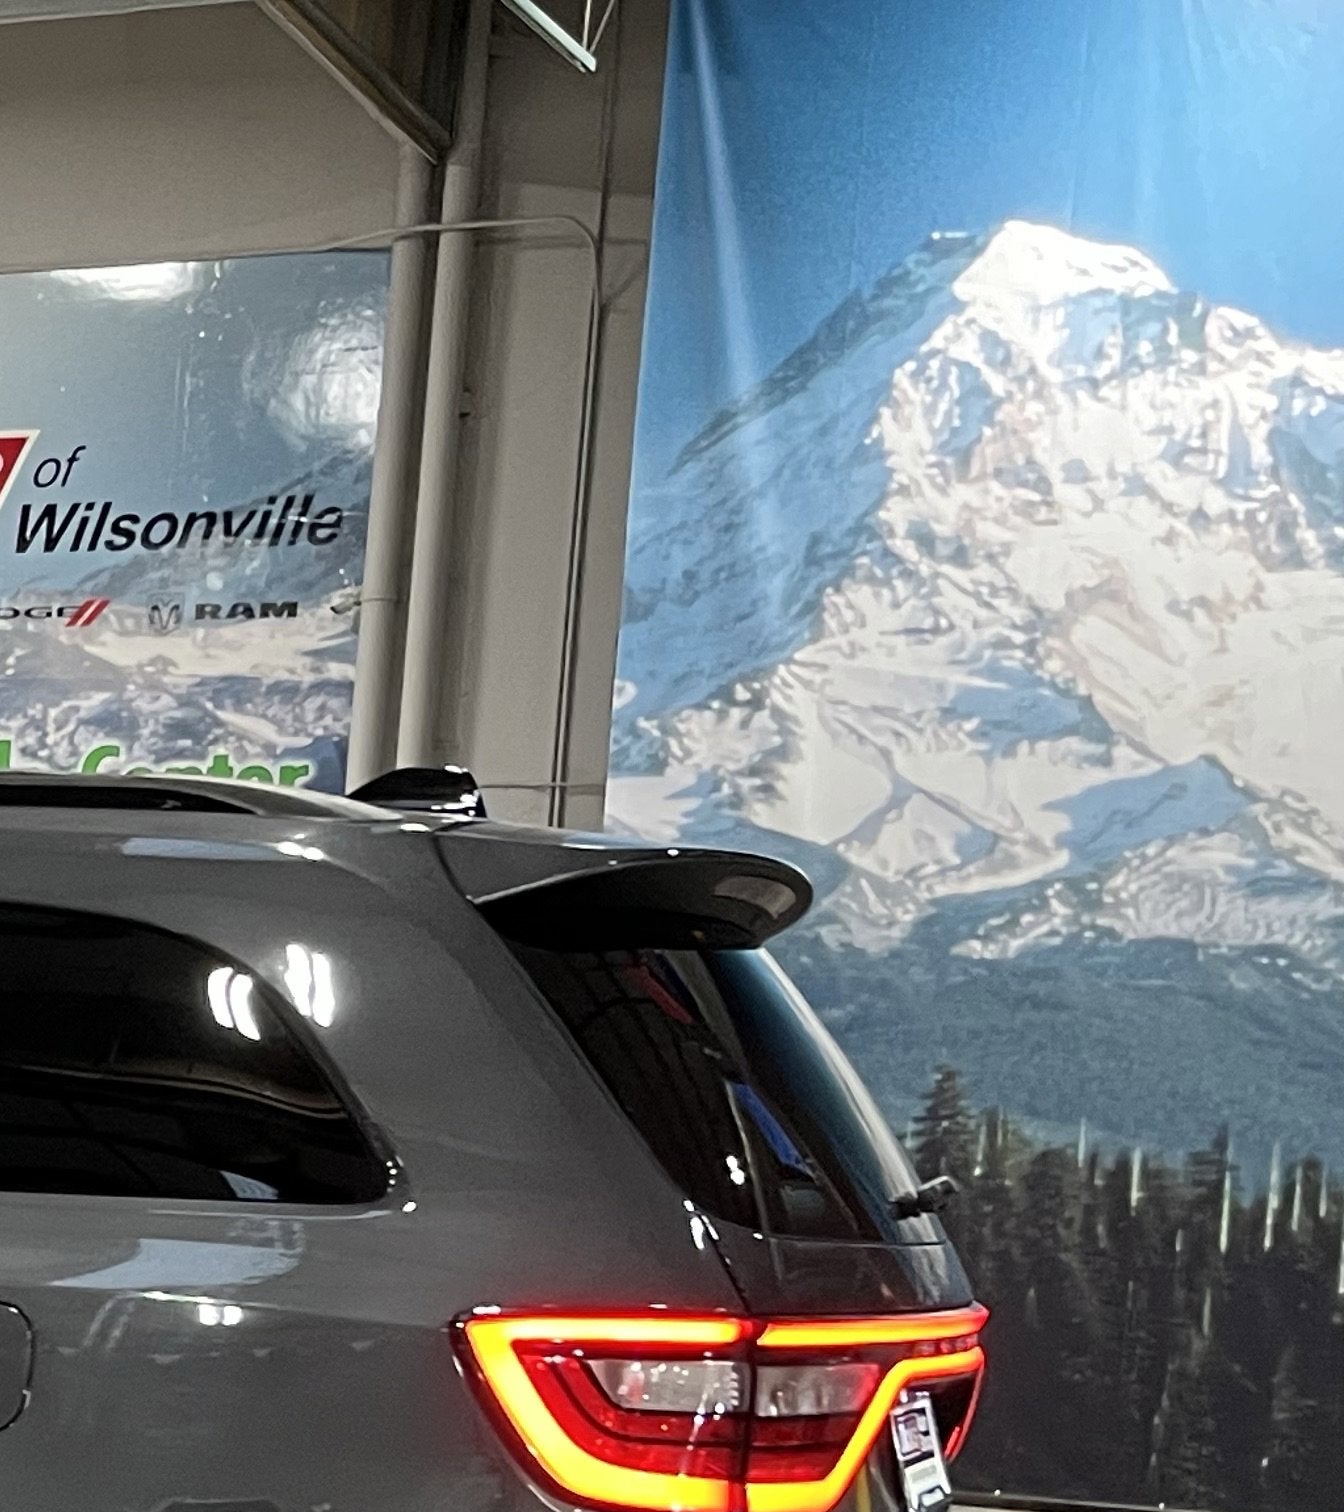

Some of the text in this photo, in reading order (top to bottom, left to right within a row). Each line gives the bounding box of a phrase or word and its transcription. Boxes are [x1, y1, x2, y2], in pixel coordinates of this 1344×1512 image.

[33, 445, 87, 488] of
[15, 494, 343, 554] Wilsonville
[194, 601, 299, 620] RAM
